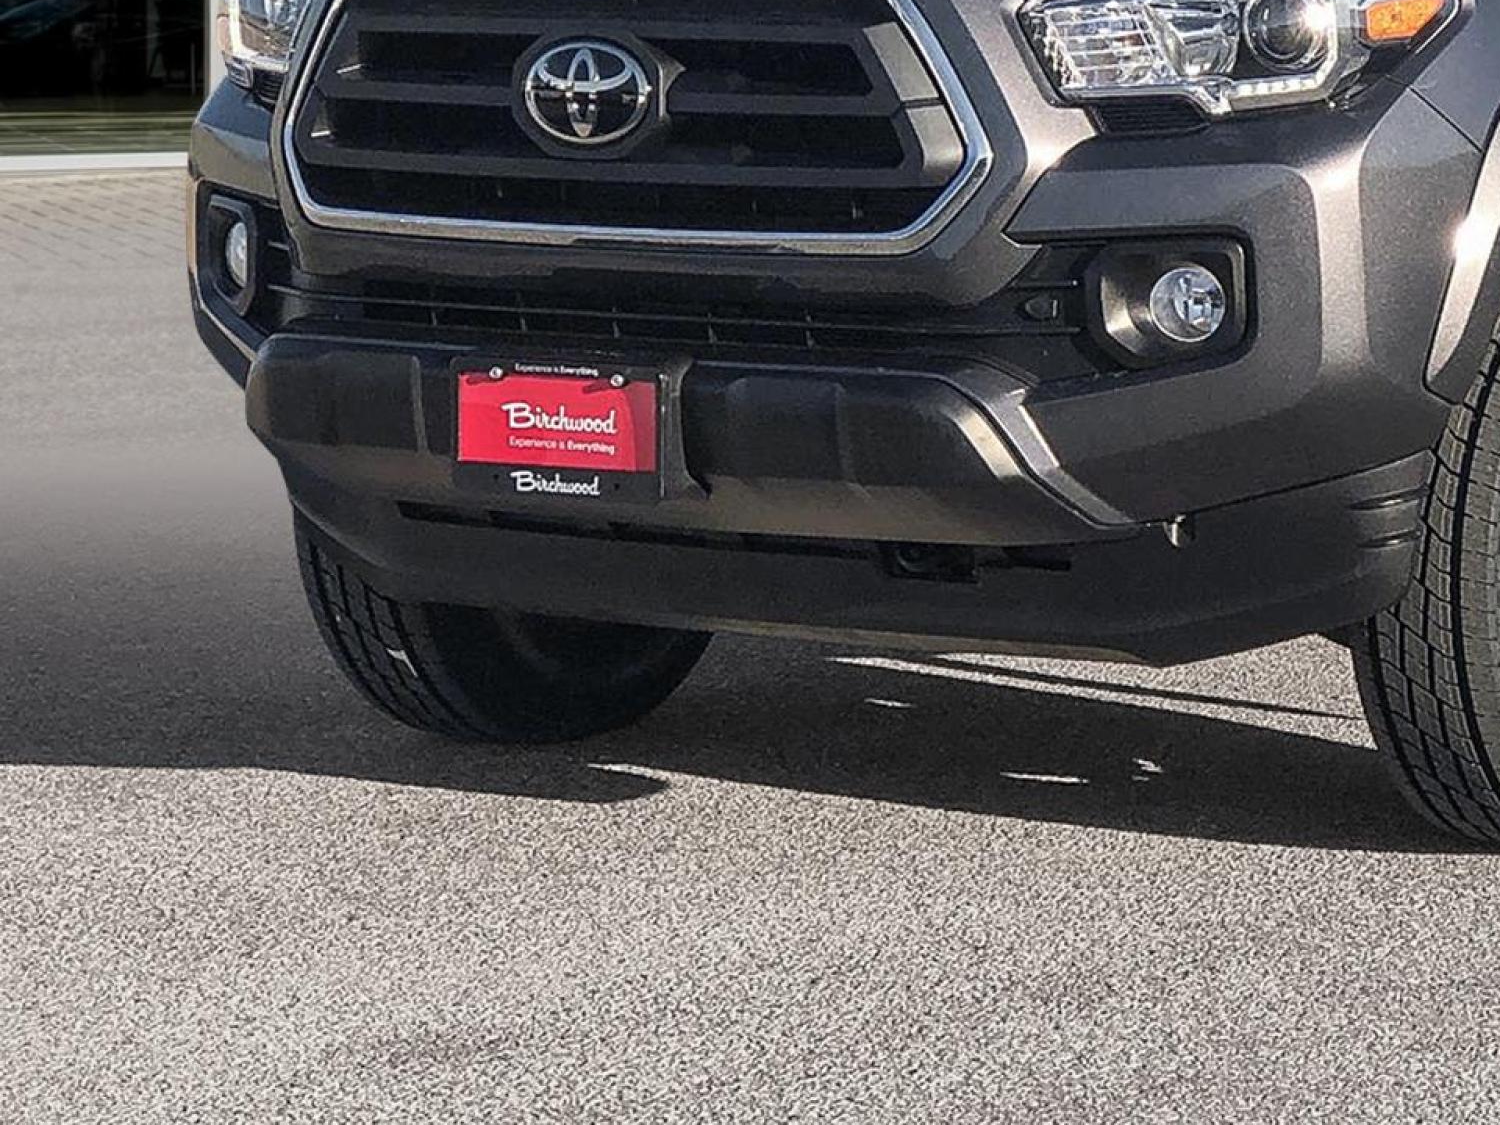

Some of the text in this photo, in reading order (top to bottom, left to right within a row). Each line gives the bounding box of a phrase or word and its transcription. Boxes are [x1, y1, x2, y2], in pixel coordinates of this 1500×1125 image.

[515, 363, 552, 373] Experience
[560, 366, 598, 376] Everything
[501, 402, 617, 433] Birchwood
[509, 436, 557, 449] Experience
[567, 440, 615, 455] Everything
[510, 471, 600, 496] Birchwood
